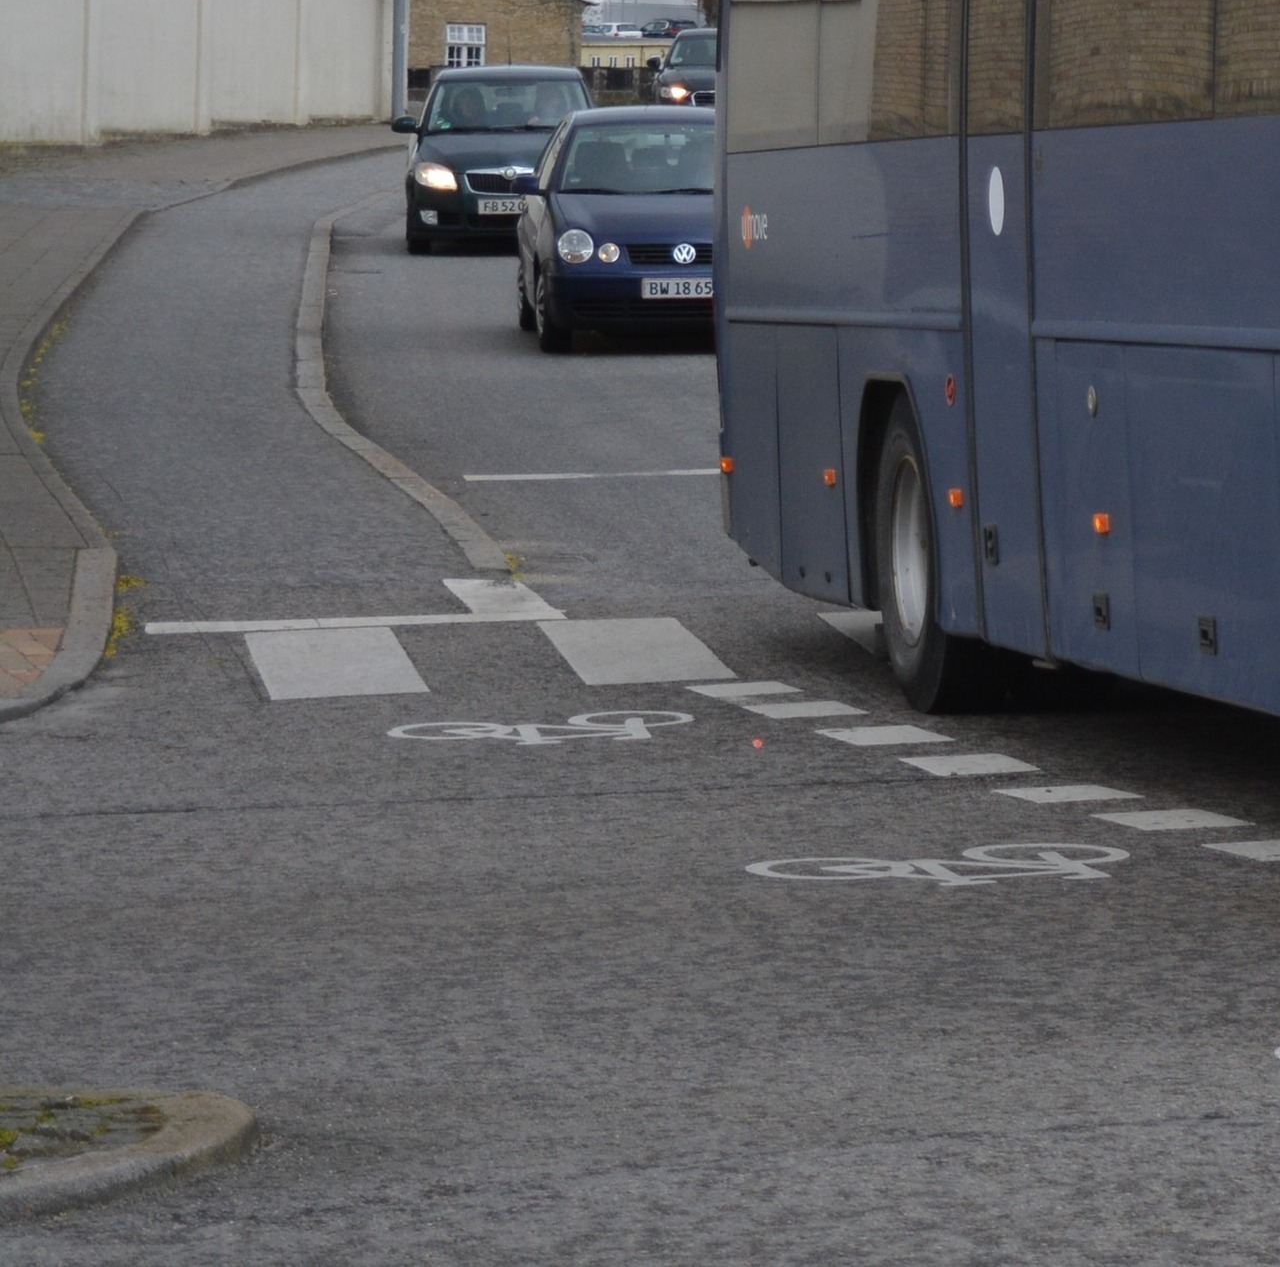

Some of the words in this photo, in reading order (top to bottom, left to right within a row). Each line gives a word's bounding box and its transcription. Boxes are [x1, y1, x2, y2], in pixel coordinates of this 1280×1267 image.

[501, 201, 516, 212] 52
[649, 281, 669, 295] BW
[675, 281, 691, 295] 18
